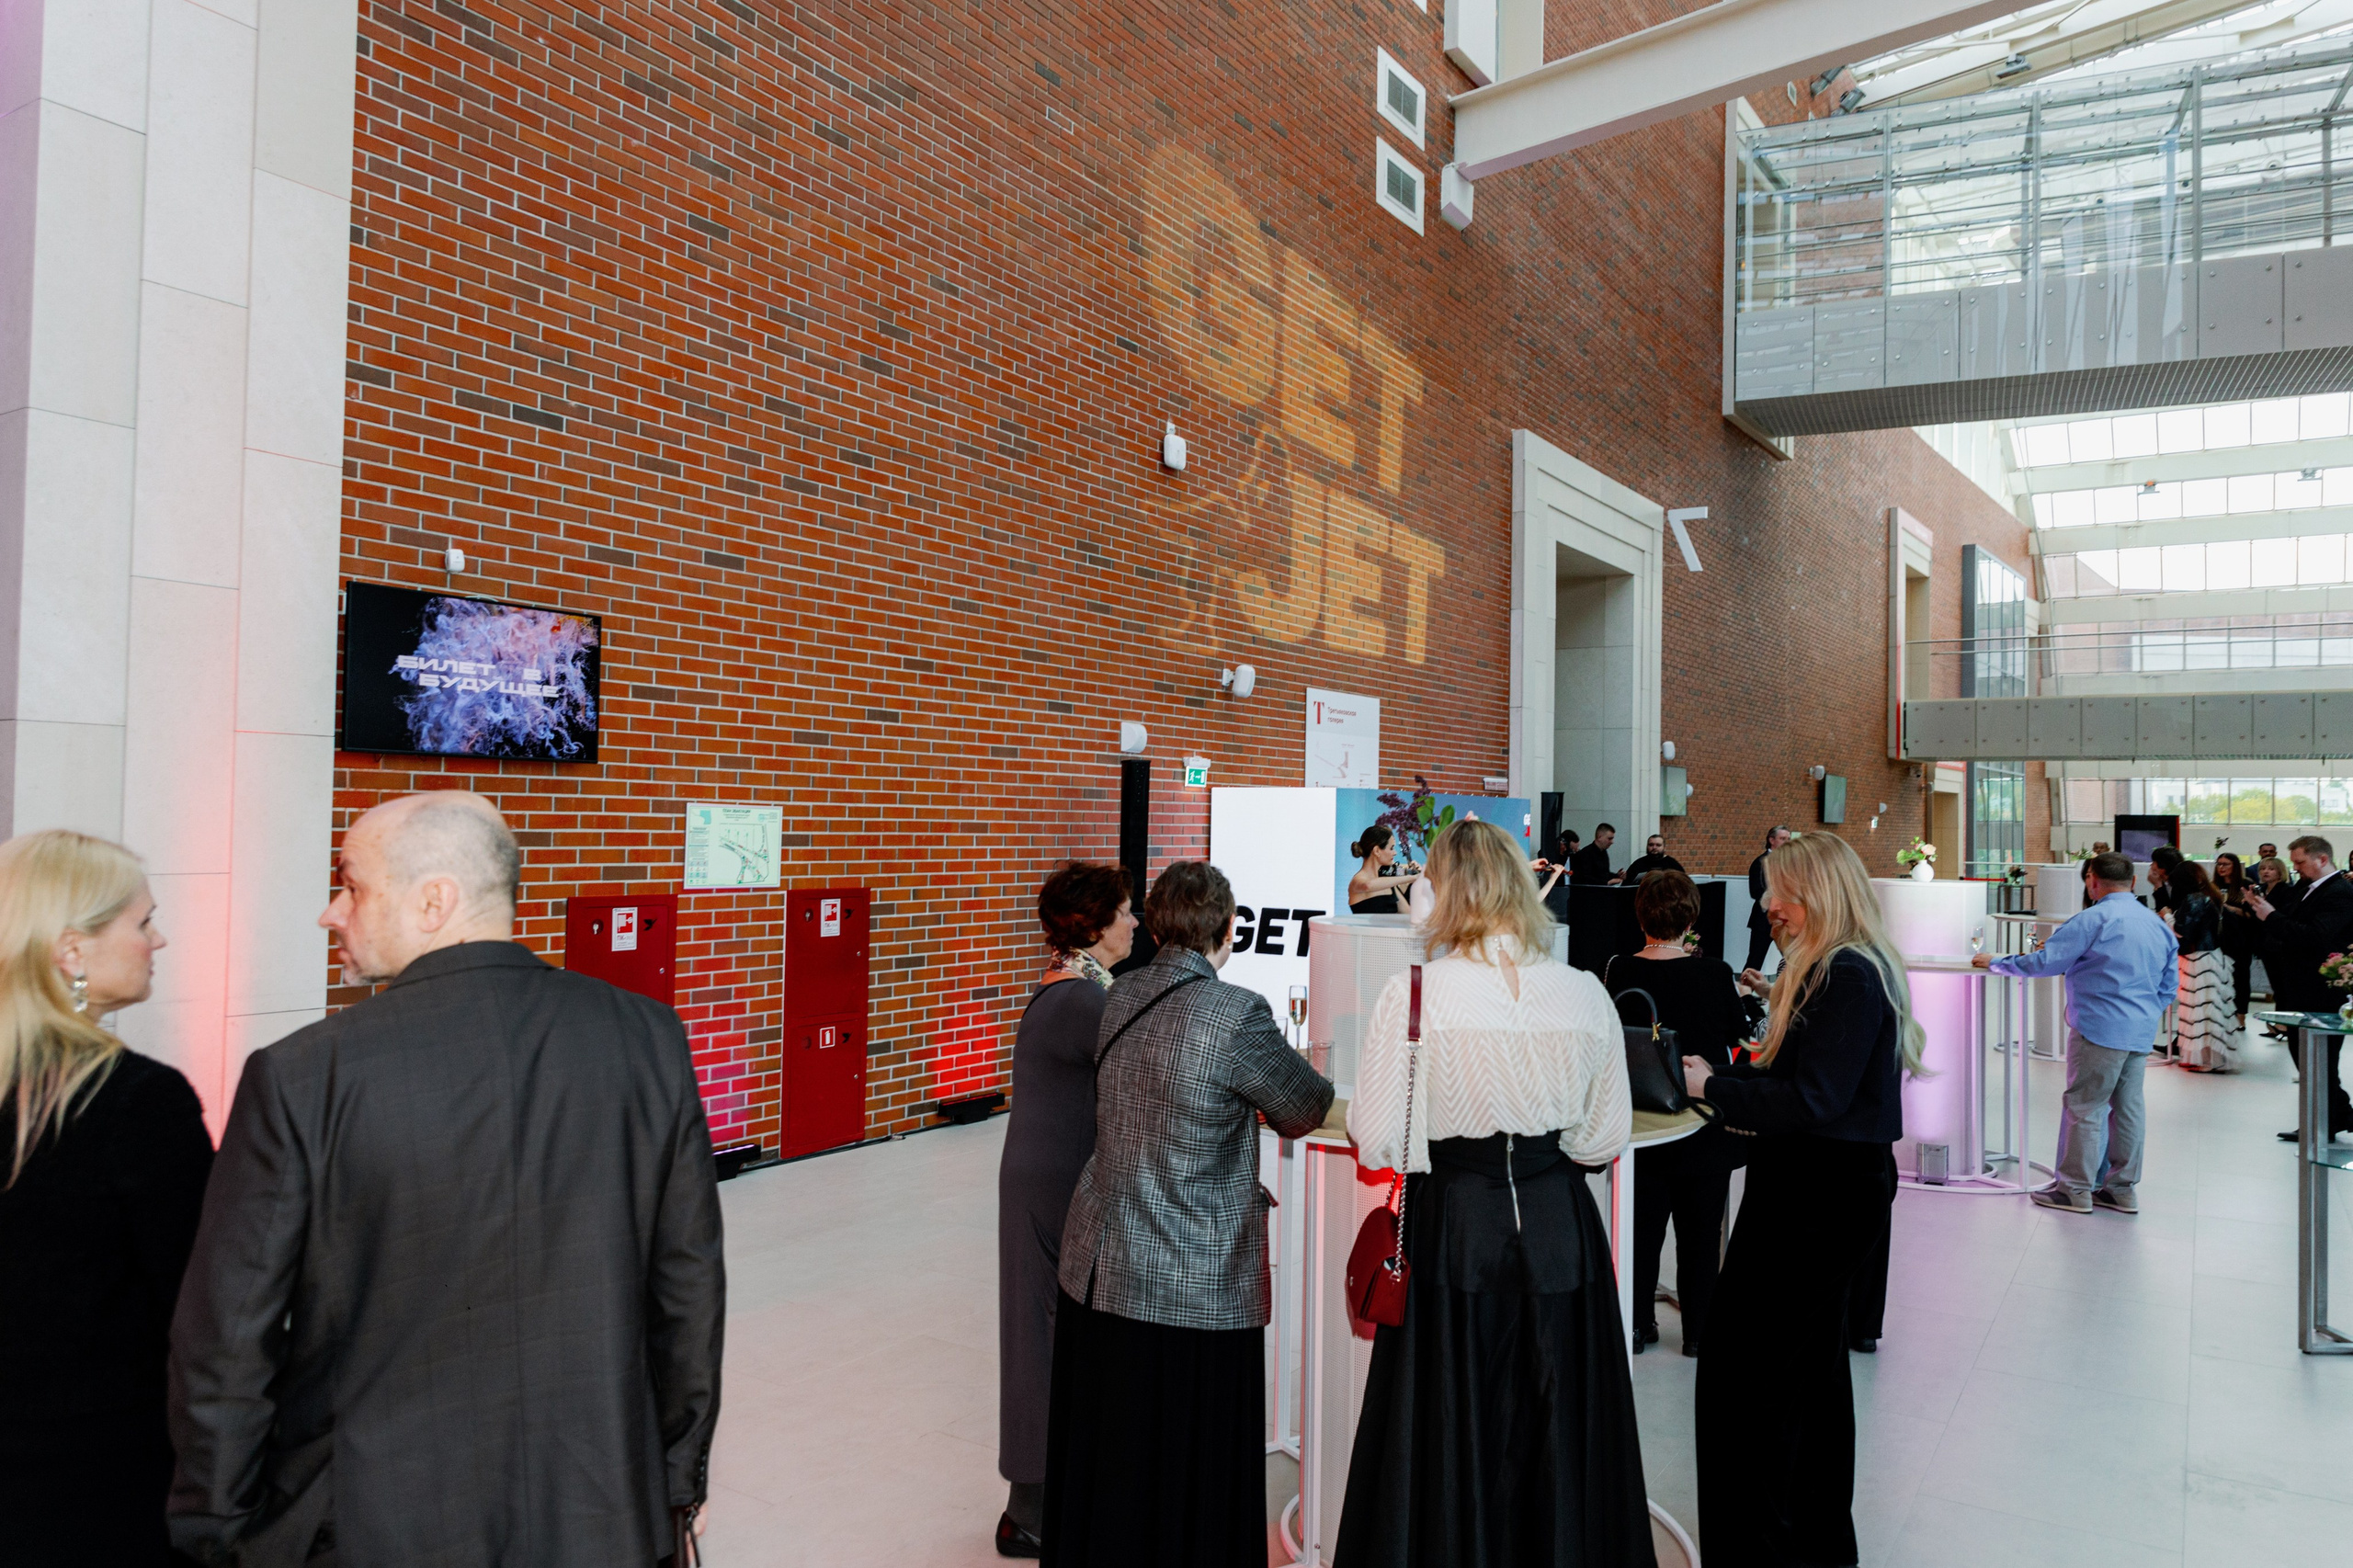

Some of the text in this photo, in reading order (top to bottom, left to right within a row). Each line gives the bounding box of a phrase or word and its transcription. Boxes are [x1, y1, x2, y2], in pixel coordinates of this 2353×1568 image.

[1142, 143, 1424, 496] GET
[1236, 469, 1445, 664] JET
[397, 654, 541, 681] БИЛЕТ В
[419, 674, 559, 698] БУДУЩЕЕ
[1231, 905, 1326, 957] GET
